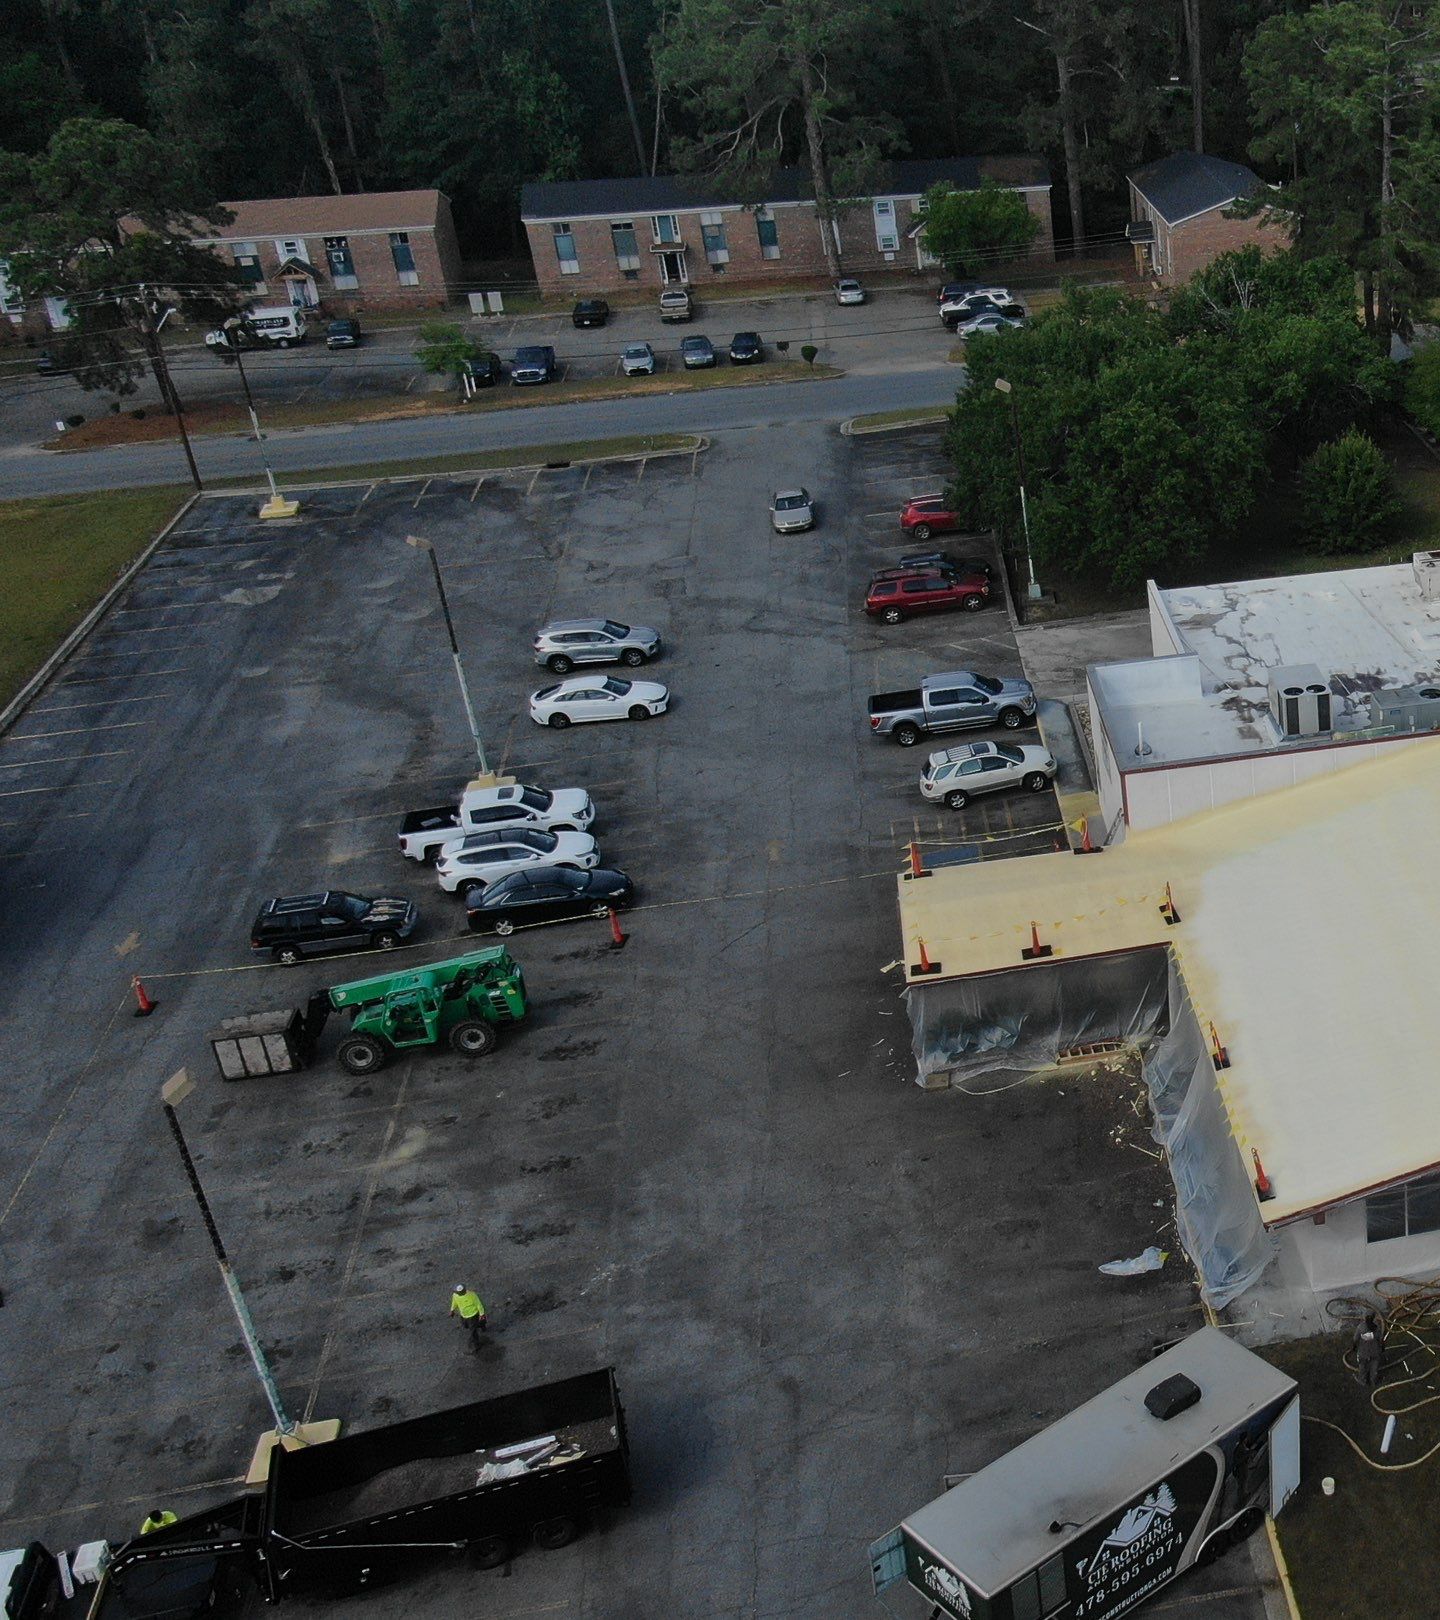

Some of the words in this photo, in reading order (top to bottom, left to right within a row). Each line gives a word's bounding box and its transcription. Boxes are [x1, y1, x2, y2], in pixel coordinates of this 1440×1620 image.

[1076, 1531, 1183, 1616] 478-595-6974
[1087, 1574, 1107, 1592] AND
[1113, 1527, 1174, 1572] INSULATION
[1110, 1518, 1172, 1572] ROOFING
